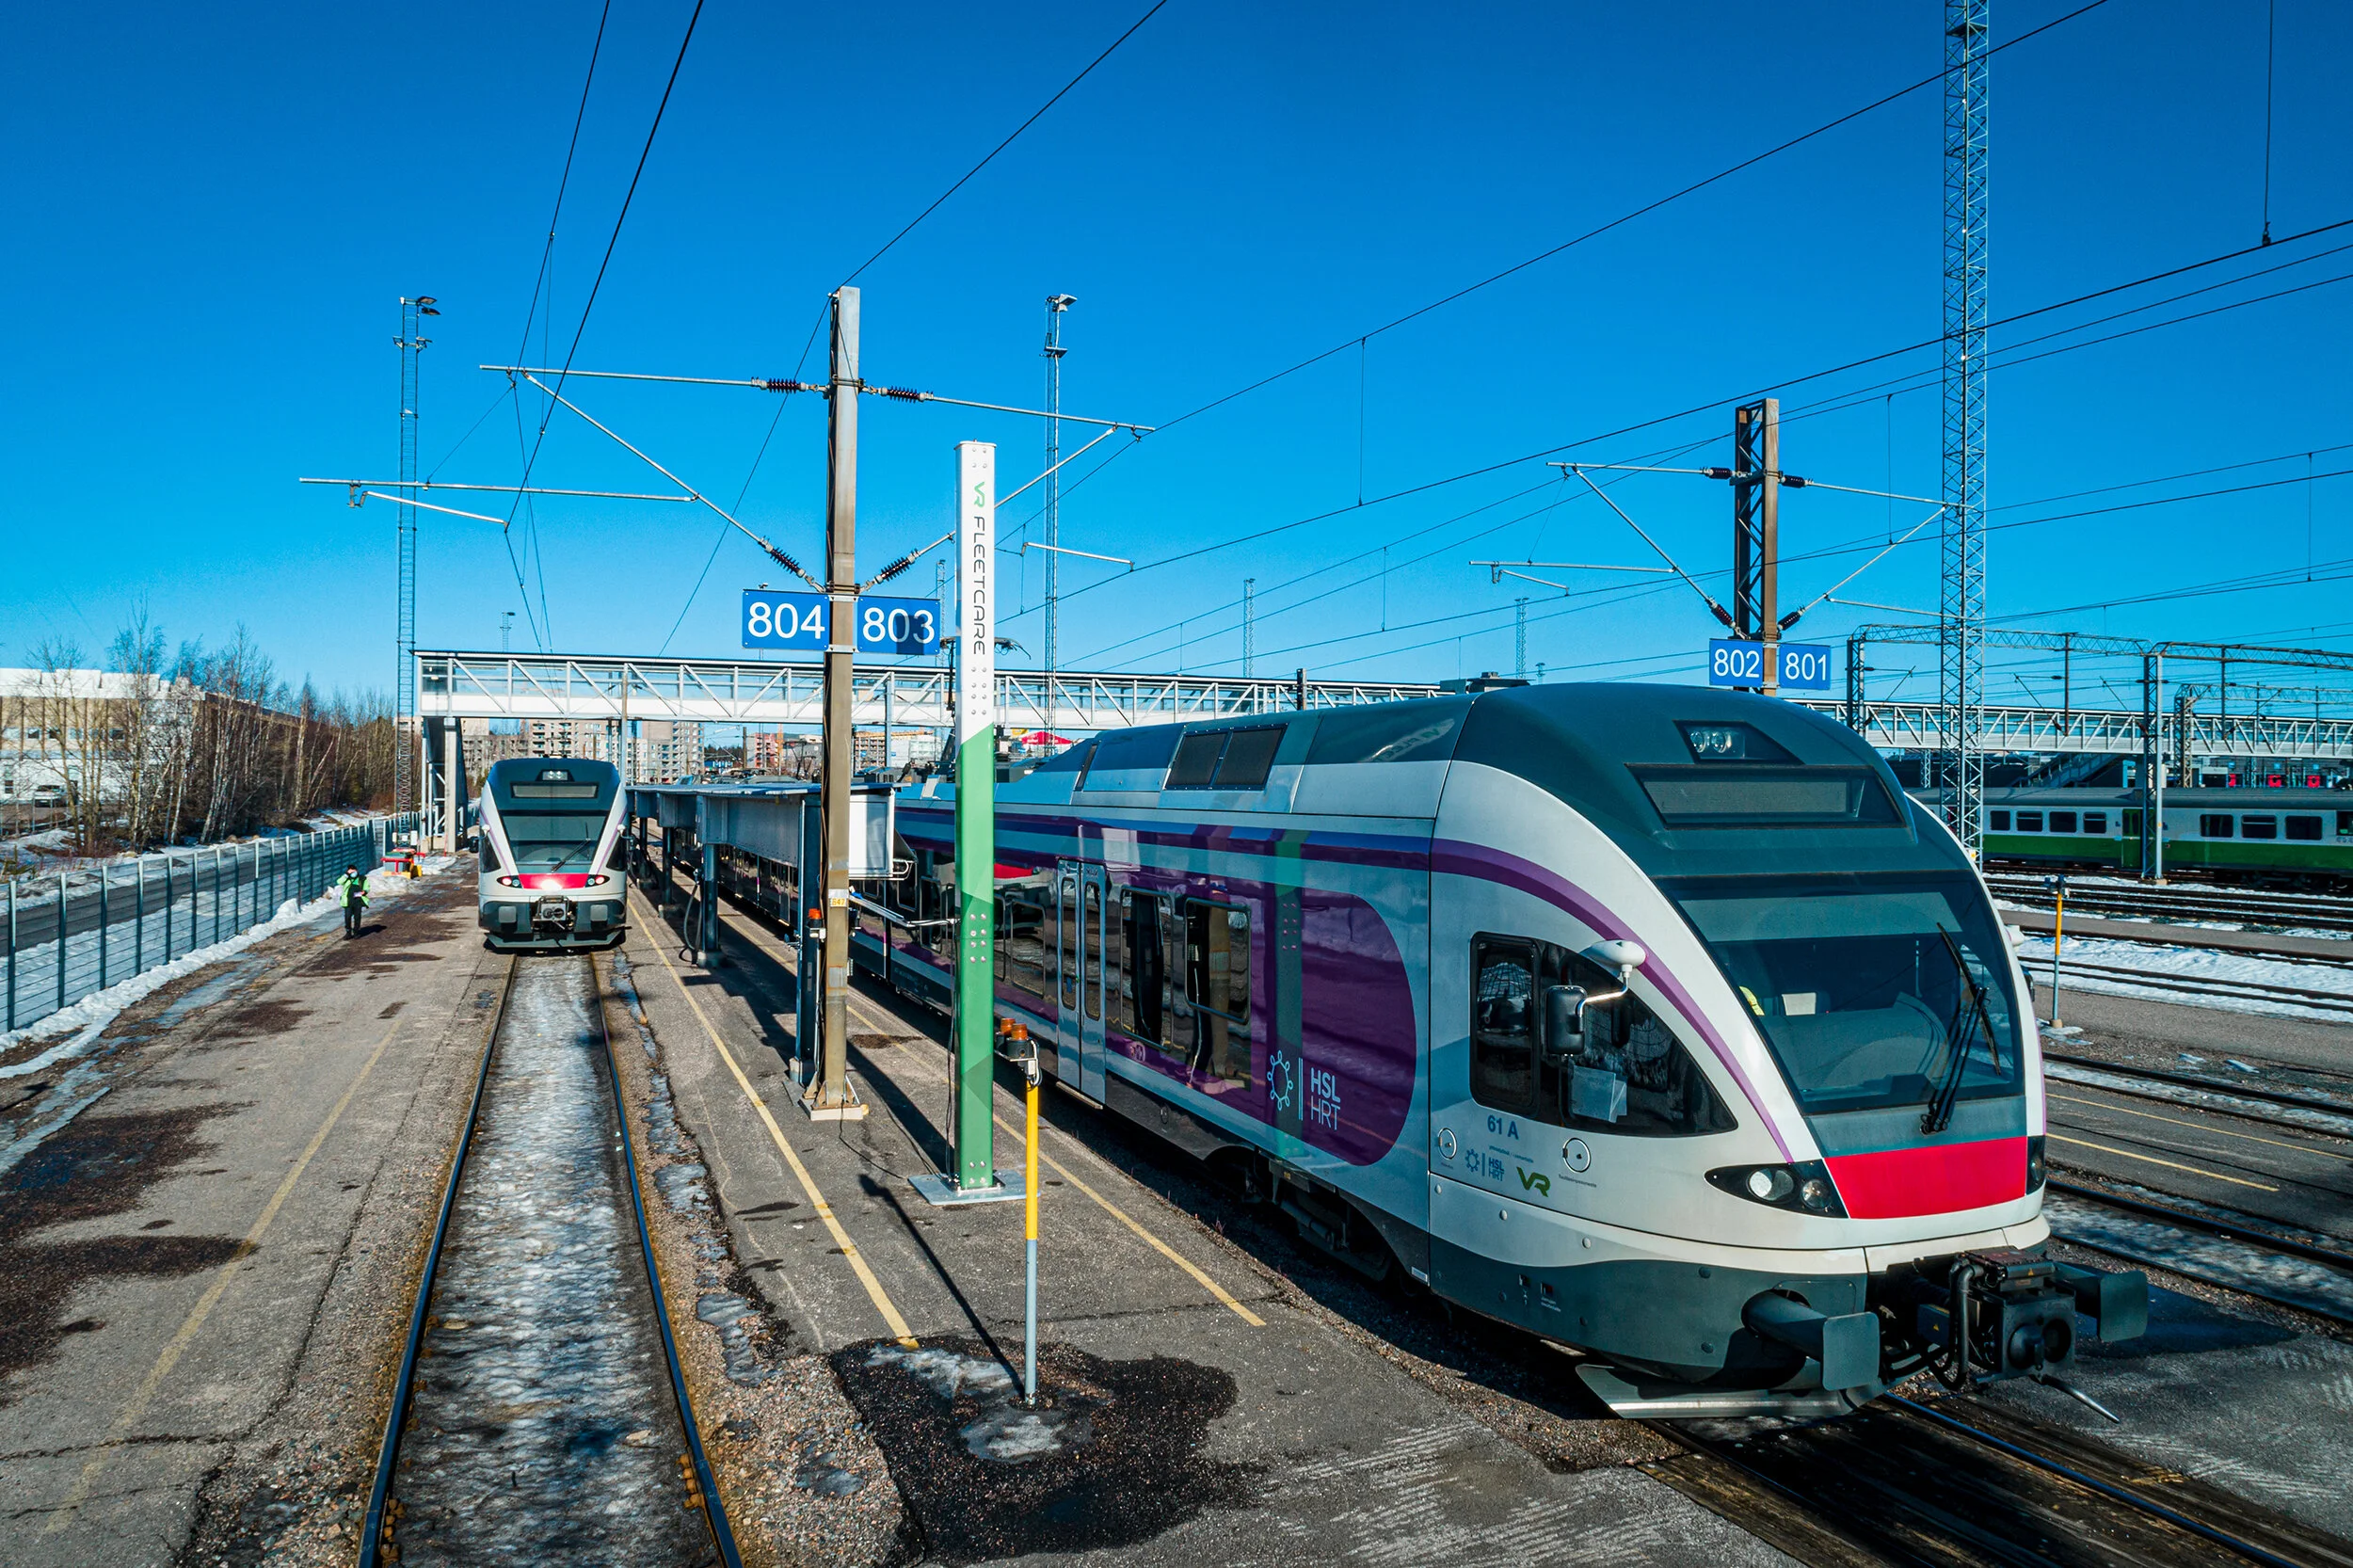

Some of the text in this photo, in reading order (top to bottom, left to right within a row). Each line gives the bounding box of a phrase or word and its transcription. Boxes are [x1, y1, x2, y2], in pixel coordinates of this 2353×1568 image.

[973, 481, 985, 655] VR FLEETCARE
[748, 601, 825, 639] 804
[863, 607, 935, 644] 803
[1714, 648, 1760, 678] 802
[1785, 652, 1826, 680] 801
[1311, 1067, 1340, 1103] HSL
[1311, 1096, 1340, 1130] HRT
[1487, 1114, 1520, 1140] 61 A
[1488, 1157, 1504, 1172] HSL
[1488, 1168, 1505, 1182] HRT
[1516, 1166, 1551, 1197] VR
